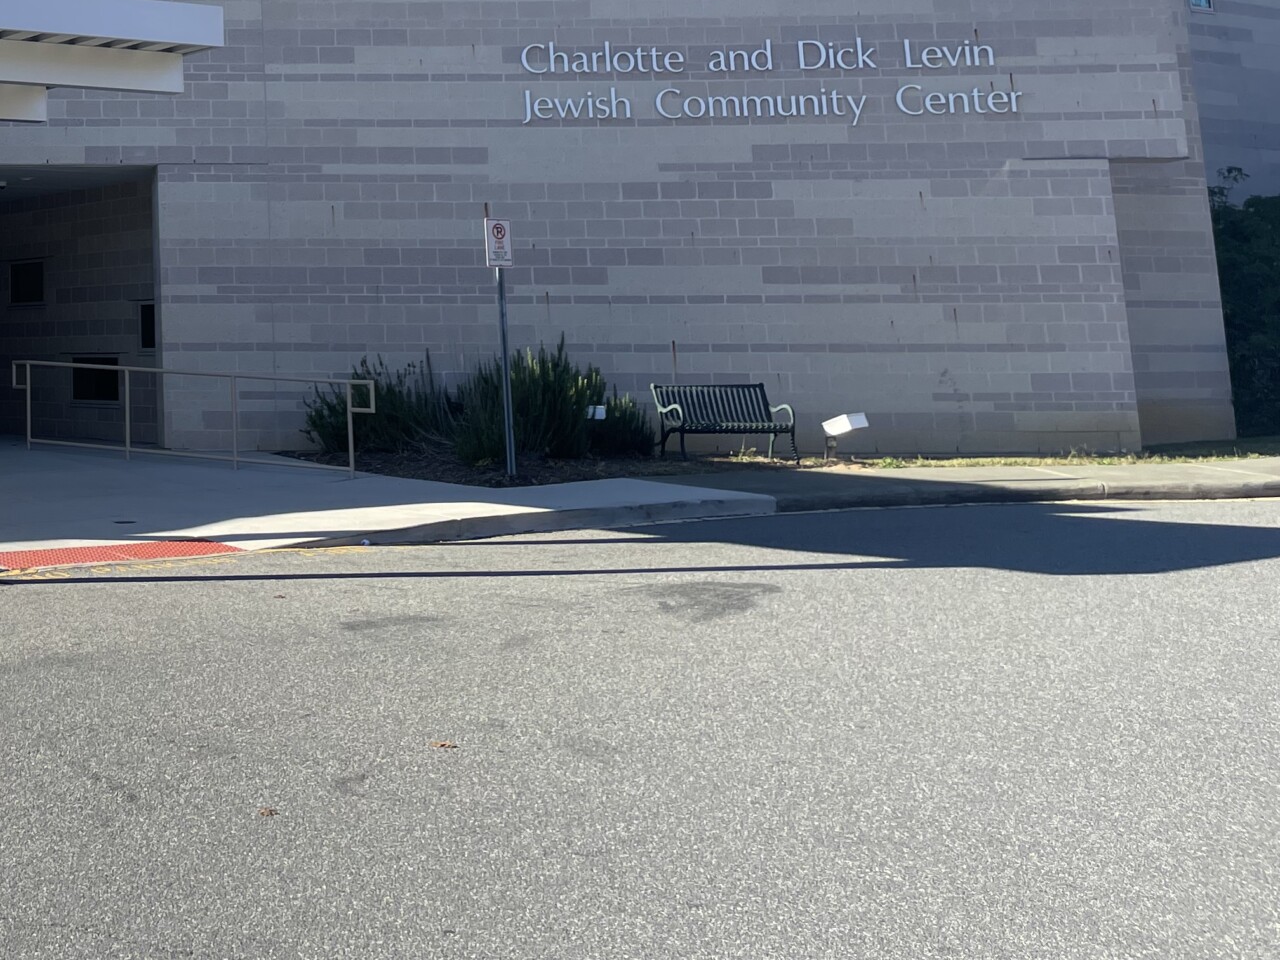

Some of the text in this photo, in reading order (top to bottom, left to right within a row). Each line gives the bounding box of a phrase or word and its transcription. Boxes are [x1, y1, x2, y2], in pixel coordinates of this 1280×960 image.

[520, 37, 995, 74] Charlotte and Dick Levin
[522, 84, 1022, 125] Jewish Community Center
